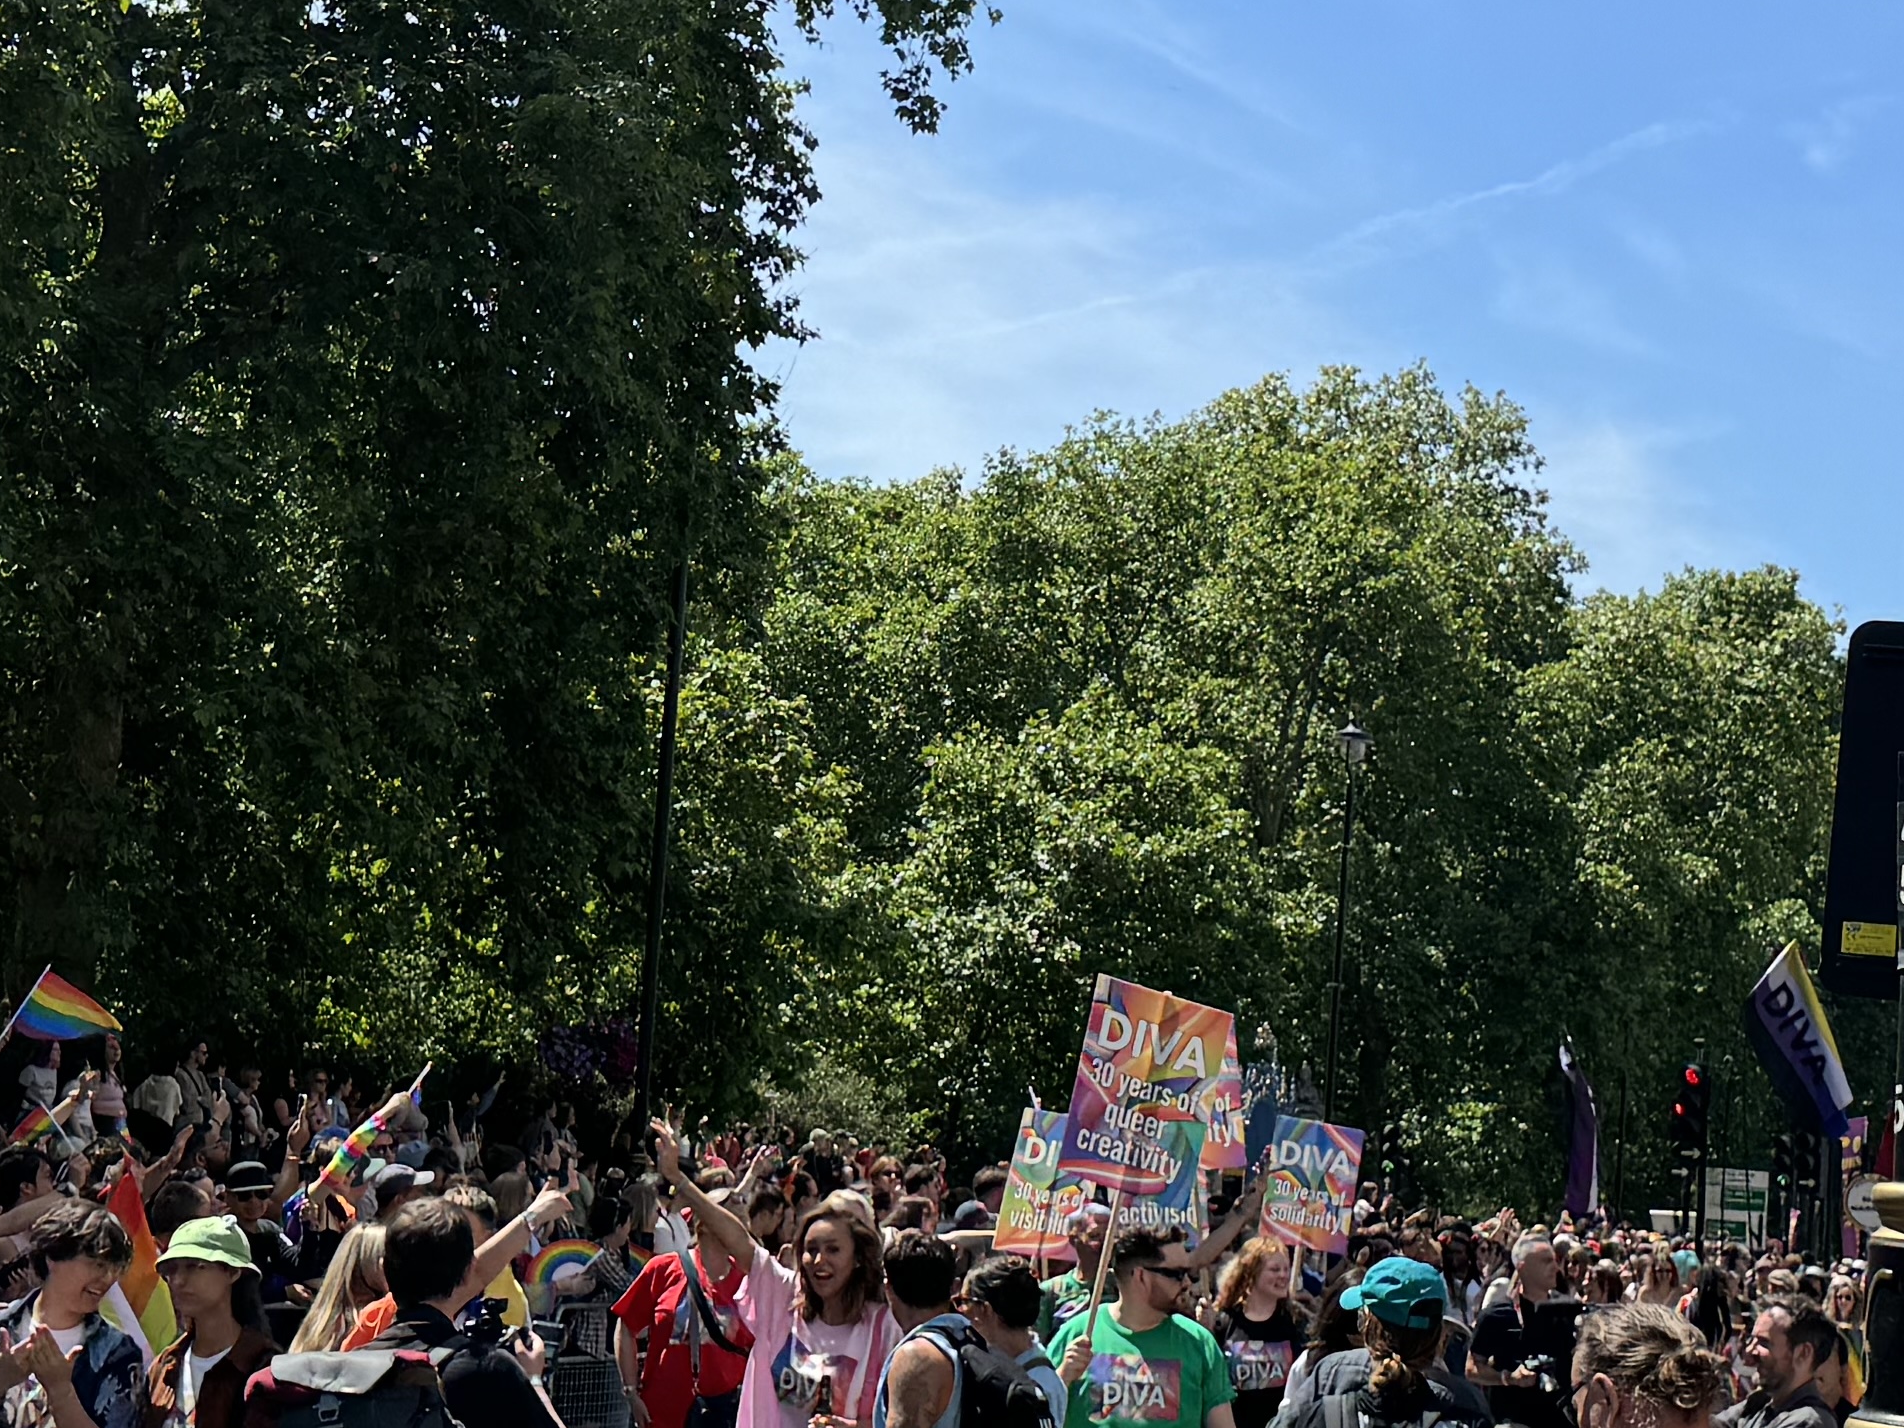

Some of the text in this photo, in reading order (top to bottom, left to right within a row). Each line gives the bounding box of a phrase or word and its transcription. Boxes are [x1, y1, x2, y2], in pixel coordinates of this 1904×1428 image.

[1098, 1009, 1206, 1079] DIVA
[1762, 981, 1827, 1084] DIVA
[1092, 1057, 1200, 1115] 30 years of
[1104, 1103, 1168, 1140] queer
[1023, 1136, 1062, 1167] DI
[1077, 1128, 1182, 1184] creativity
[1279, 1140, 1350, 1176] DIVA
[1274, 1178, 1291, 1195] 30
[1293, 1186, 1329, 1204] years
[1270, 1206, 1342, 1236] solidarity
[1236, 1361, 1285, 1381] DIVA
[1103, 1382, 1166, 1409] DIVA
